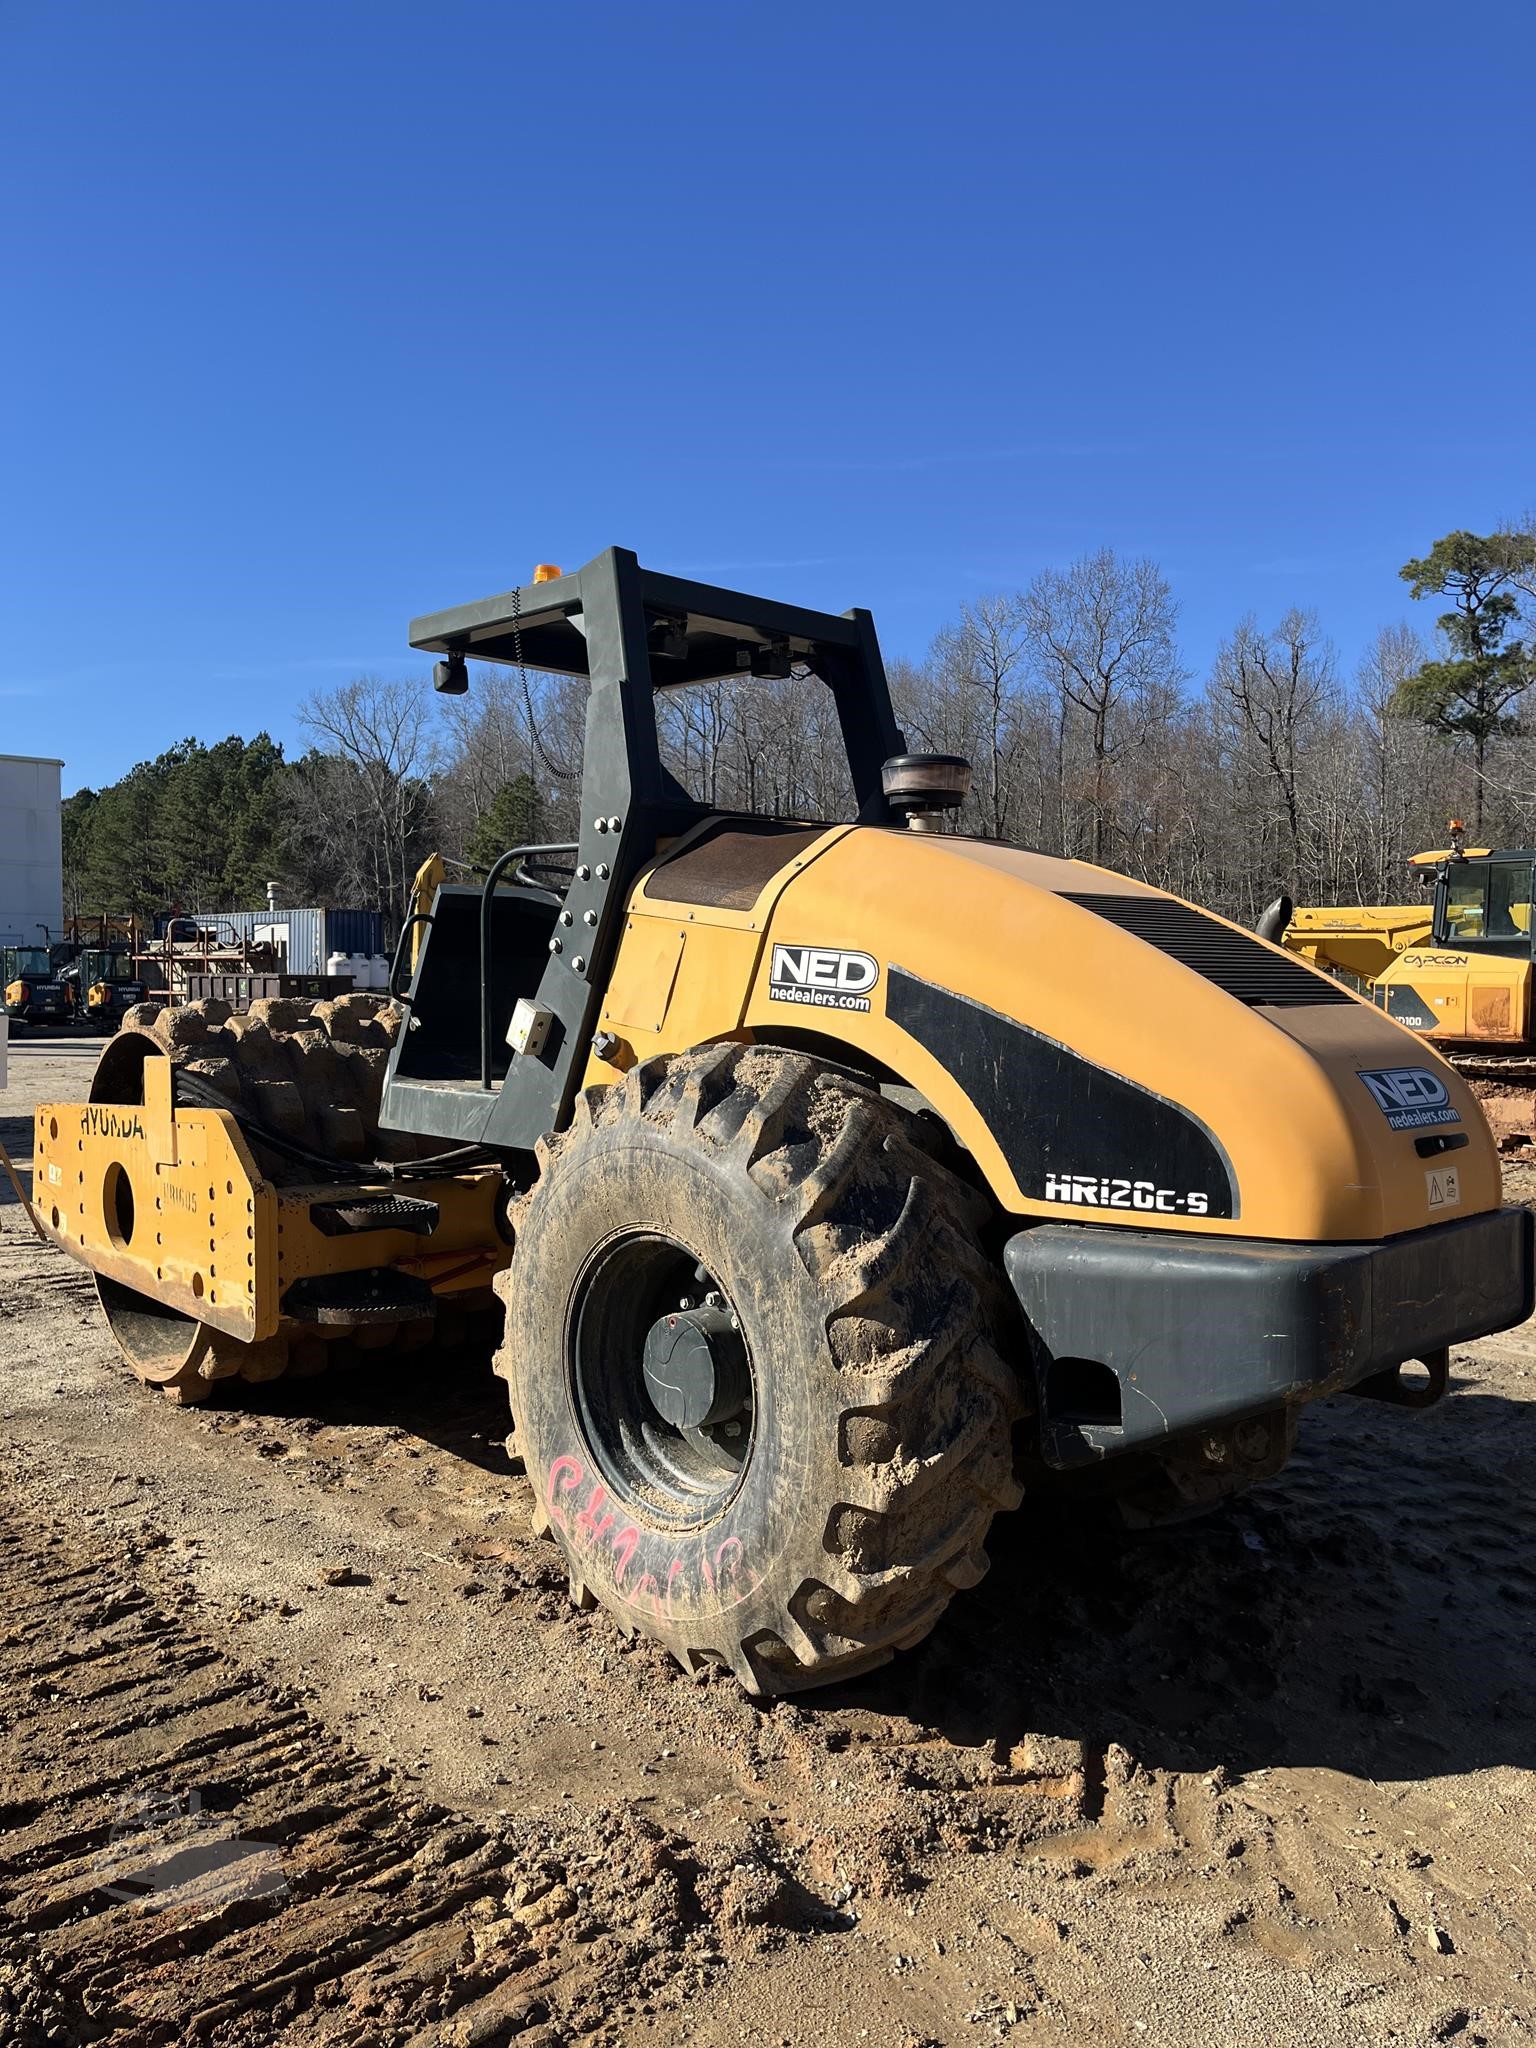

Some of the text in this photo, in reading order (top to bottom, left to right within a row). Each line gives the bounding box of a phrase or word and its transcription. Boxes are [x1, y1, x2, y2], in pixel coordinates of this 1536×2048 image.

[772, 948, 877, 991] NED
[1403, 955, 1468, 968] CAPCON
[770, 986, 870, 1011] nedealers.com
[1361, 1070, 1447, 1109] NED
[1389, 1108, 1459, 1128] nedealers.com
